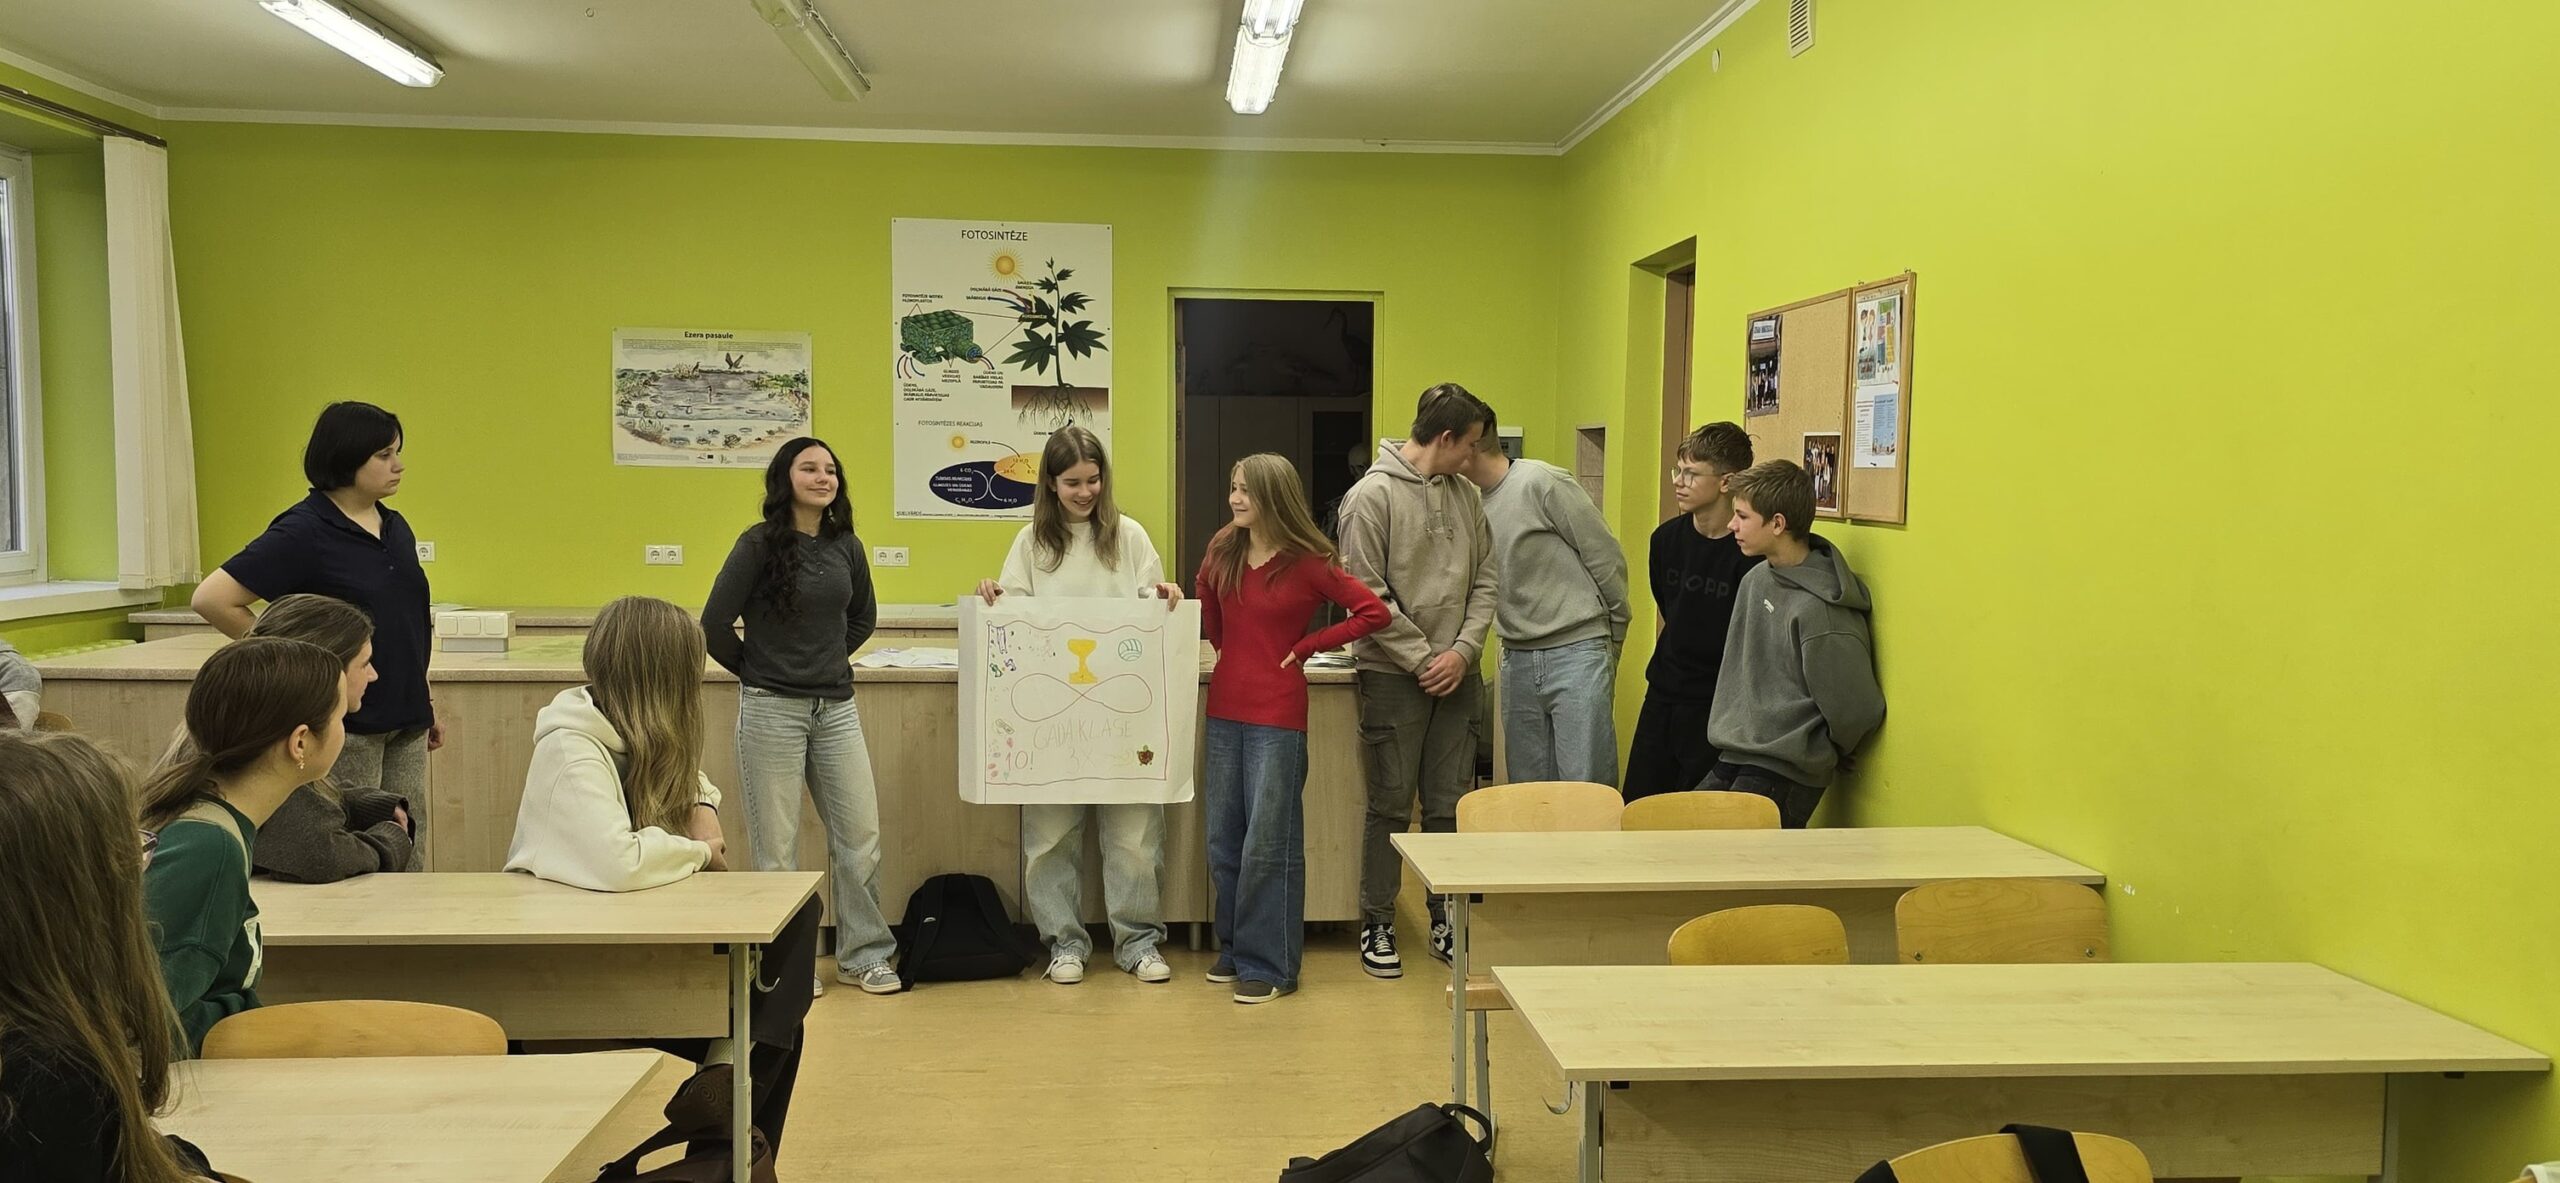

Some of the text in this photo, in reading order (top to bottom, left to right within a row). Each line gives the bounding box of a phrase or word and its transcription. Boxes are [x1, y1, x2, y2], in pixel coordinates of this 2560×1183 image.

[961, 230, 1028, 241] FOTOSINTĒZE
[705, 332, 734, 340] pasaule
[1078, 717, 1133, 743] KLASE
[1006, 750, 1034, 771] 10!
